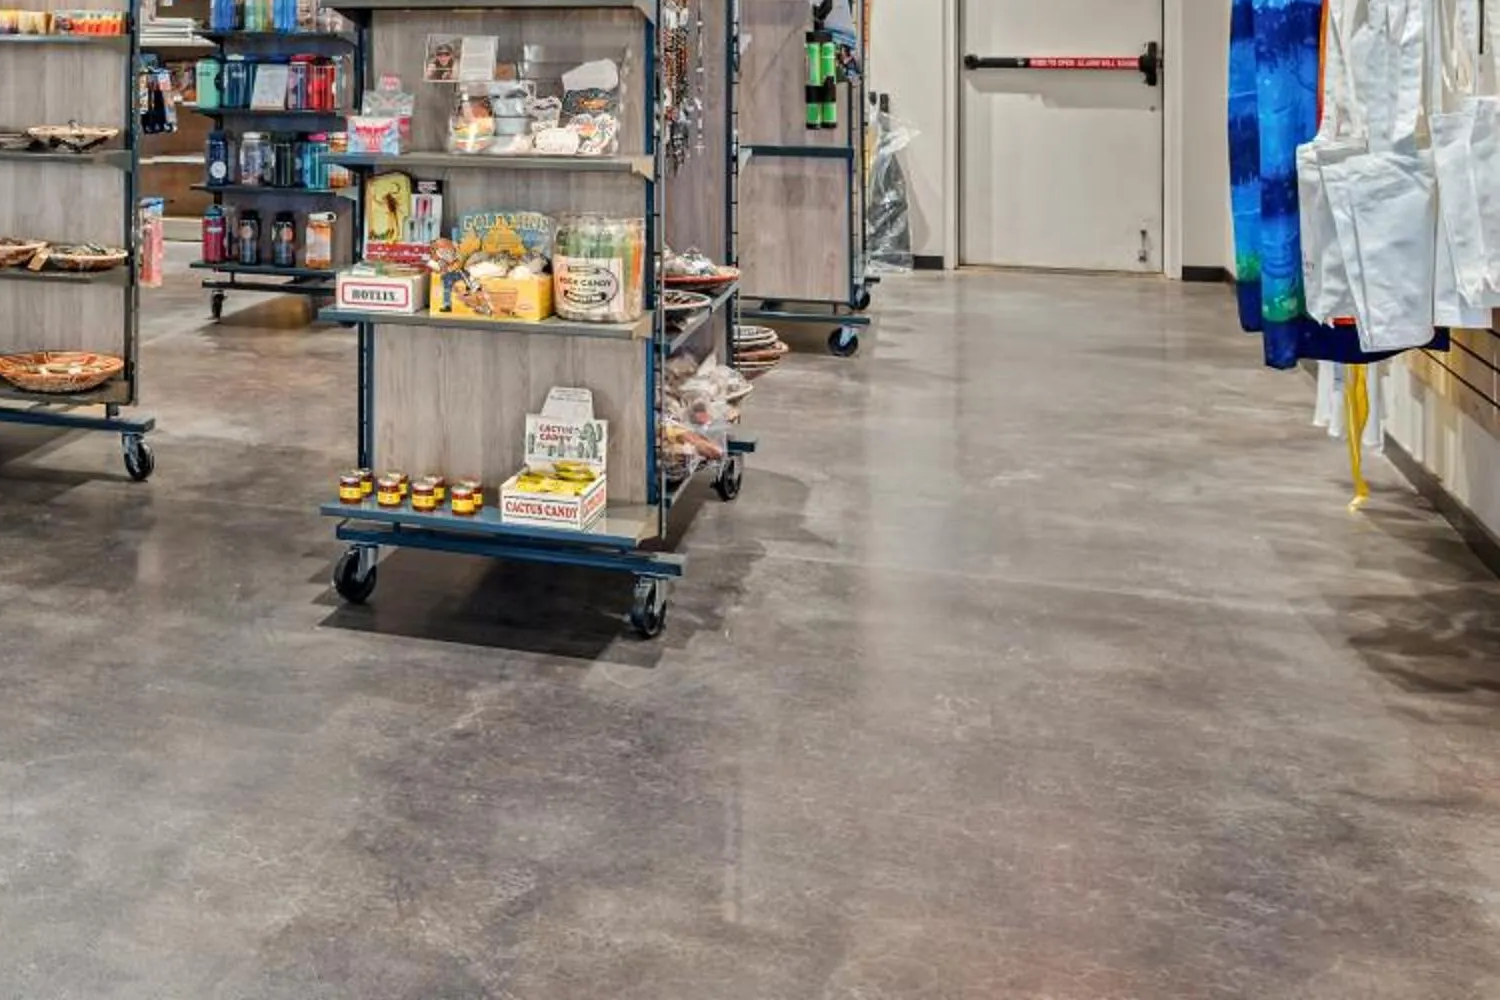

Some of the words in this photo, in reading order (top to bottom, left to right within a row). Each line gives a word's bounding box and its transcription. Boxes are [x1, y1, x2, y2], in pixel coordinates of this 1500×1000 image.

[463, 213, 507, 230] GOLD
[580, 279, 612, 287] CANDY
[539, 423, 574, 434] CACTUS
[505, 501, 543, 516] CACTUS
[545, 503, 579, 518] CANDY
